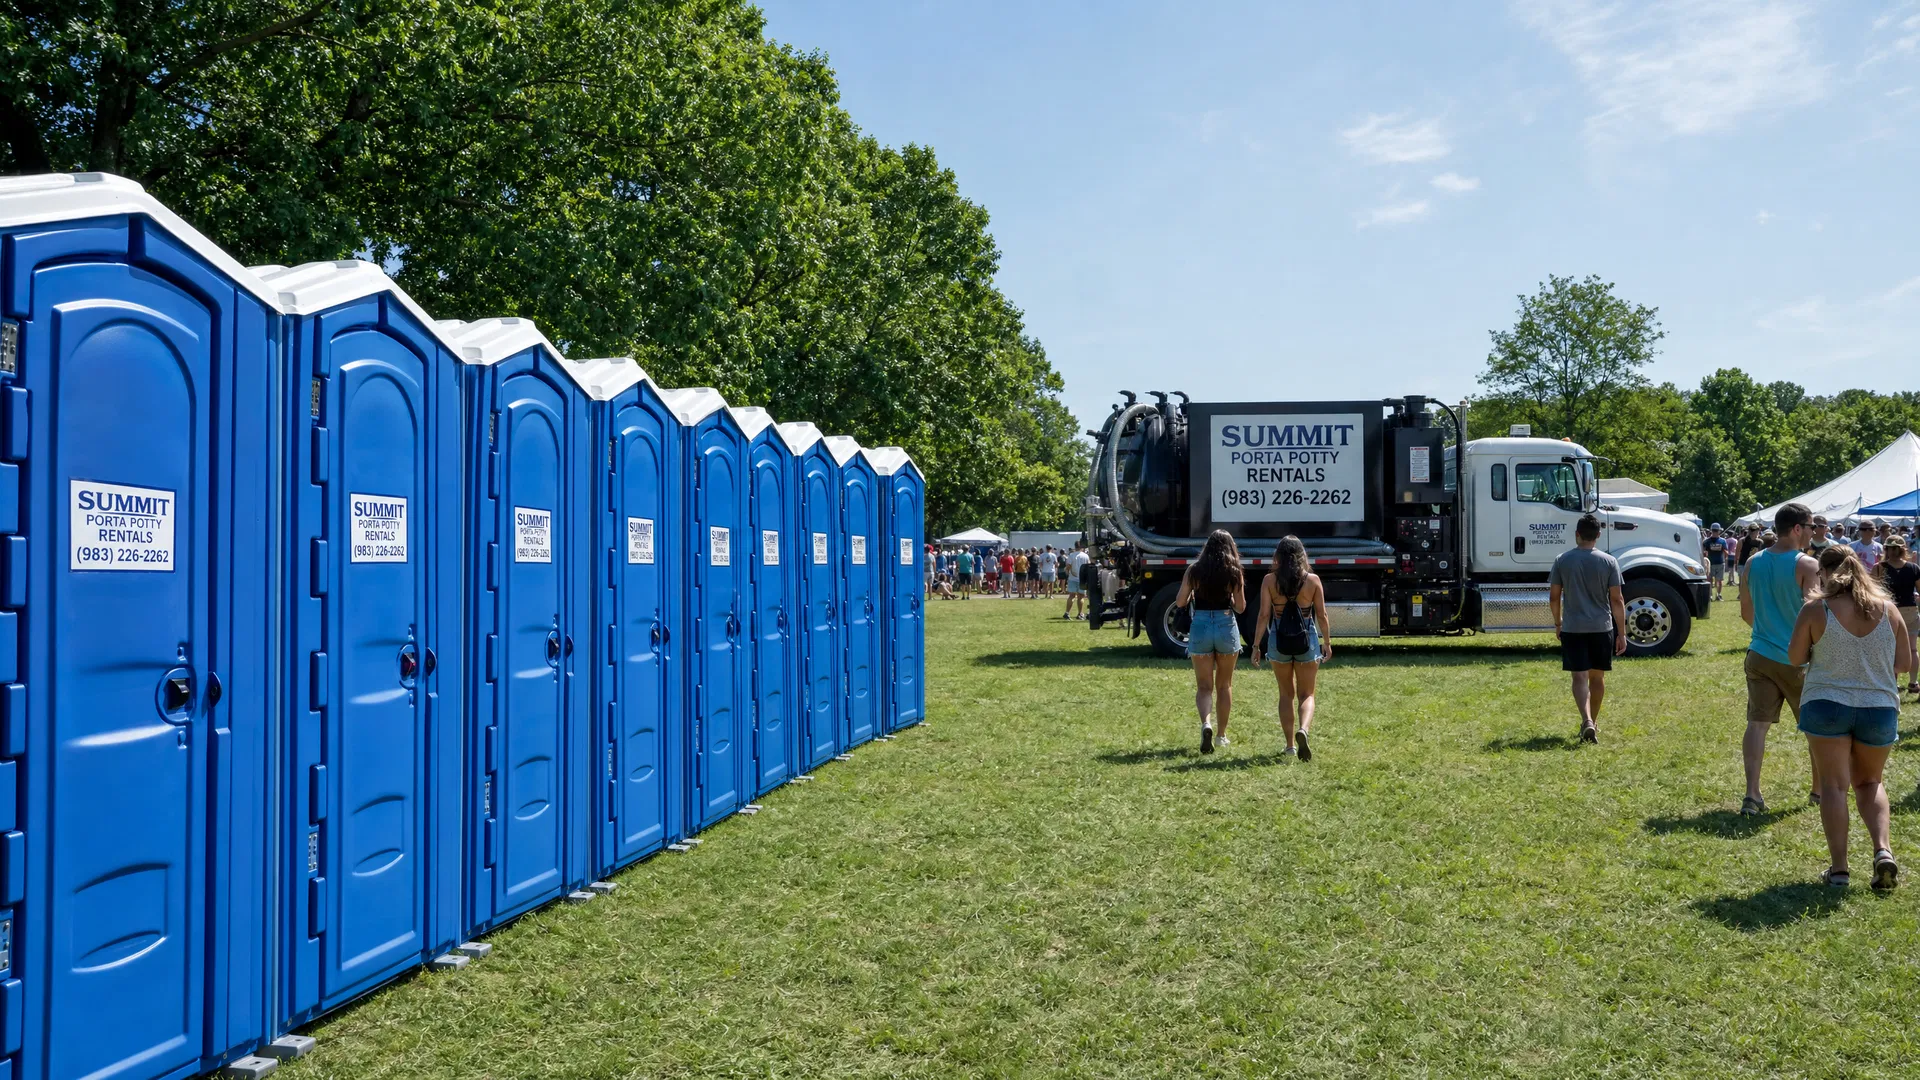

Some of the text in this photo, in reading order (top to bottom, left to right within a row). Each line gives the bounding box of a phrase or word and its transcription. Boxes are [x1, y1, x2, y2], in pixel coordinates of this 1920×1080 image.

[1221, 425, 1354, 447] SUMMIT
[1231, 451, 1339, 464] PORTA POTTY
[1247, 468, 1325, 482] RENTALS
[78, 490, 170, 516] SUMMIT
[1222, 489, 1351, 508] (983) 226-2262
[354, 501, 405, 518] SUMMIT
[86, 514, 162, 529] PORTA POTTY
[358, 519, 400, 530] PORTA POTTY
[517, 513, 549, 527] SUMMIT
[1529, 523, 1567, 531] SUMMIT
[629, 522, 653, 534] SUMMIT
[99, 529, 153, 543] RENTALS
[365, 531, 396, 541] RENTALS
[77, 547, 169, 564] (983) 226-2262
[354, 545, 374, 558] (983)
